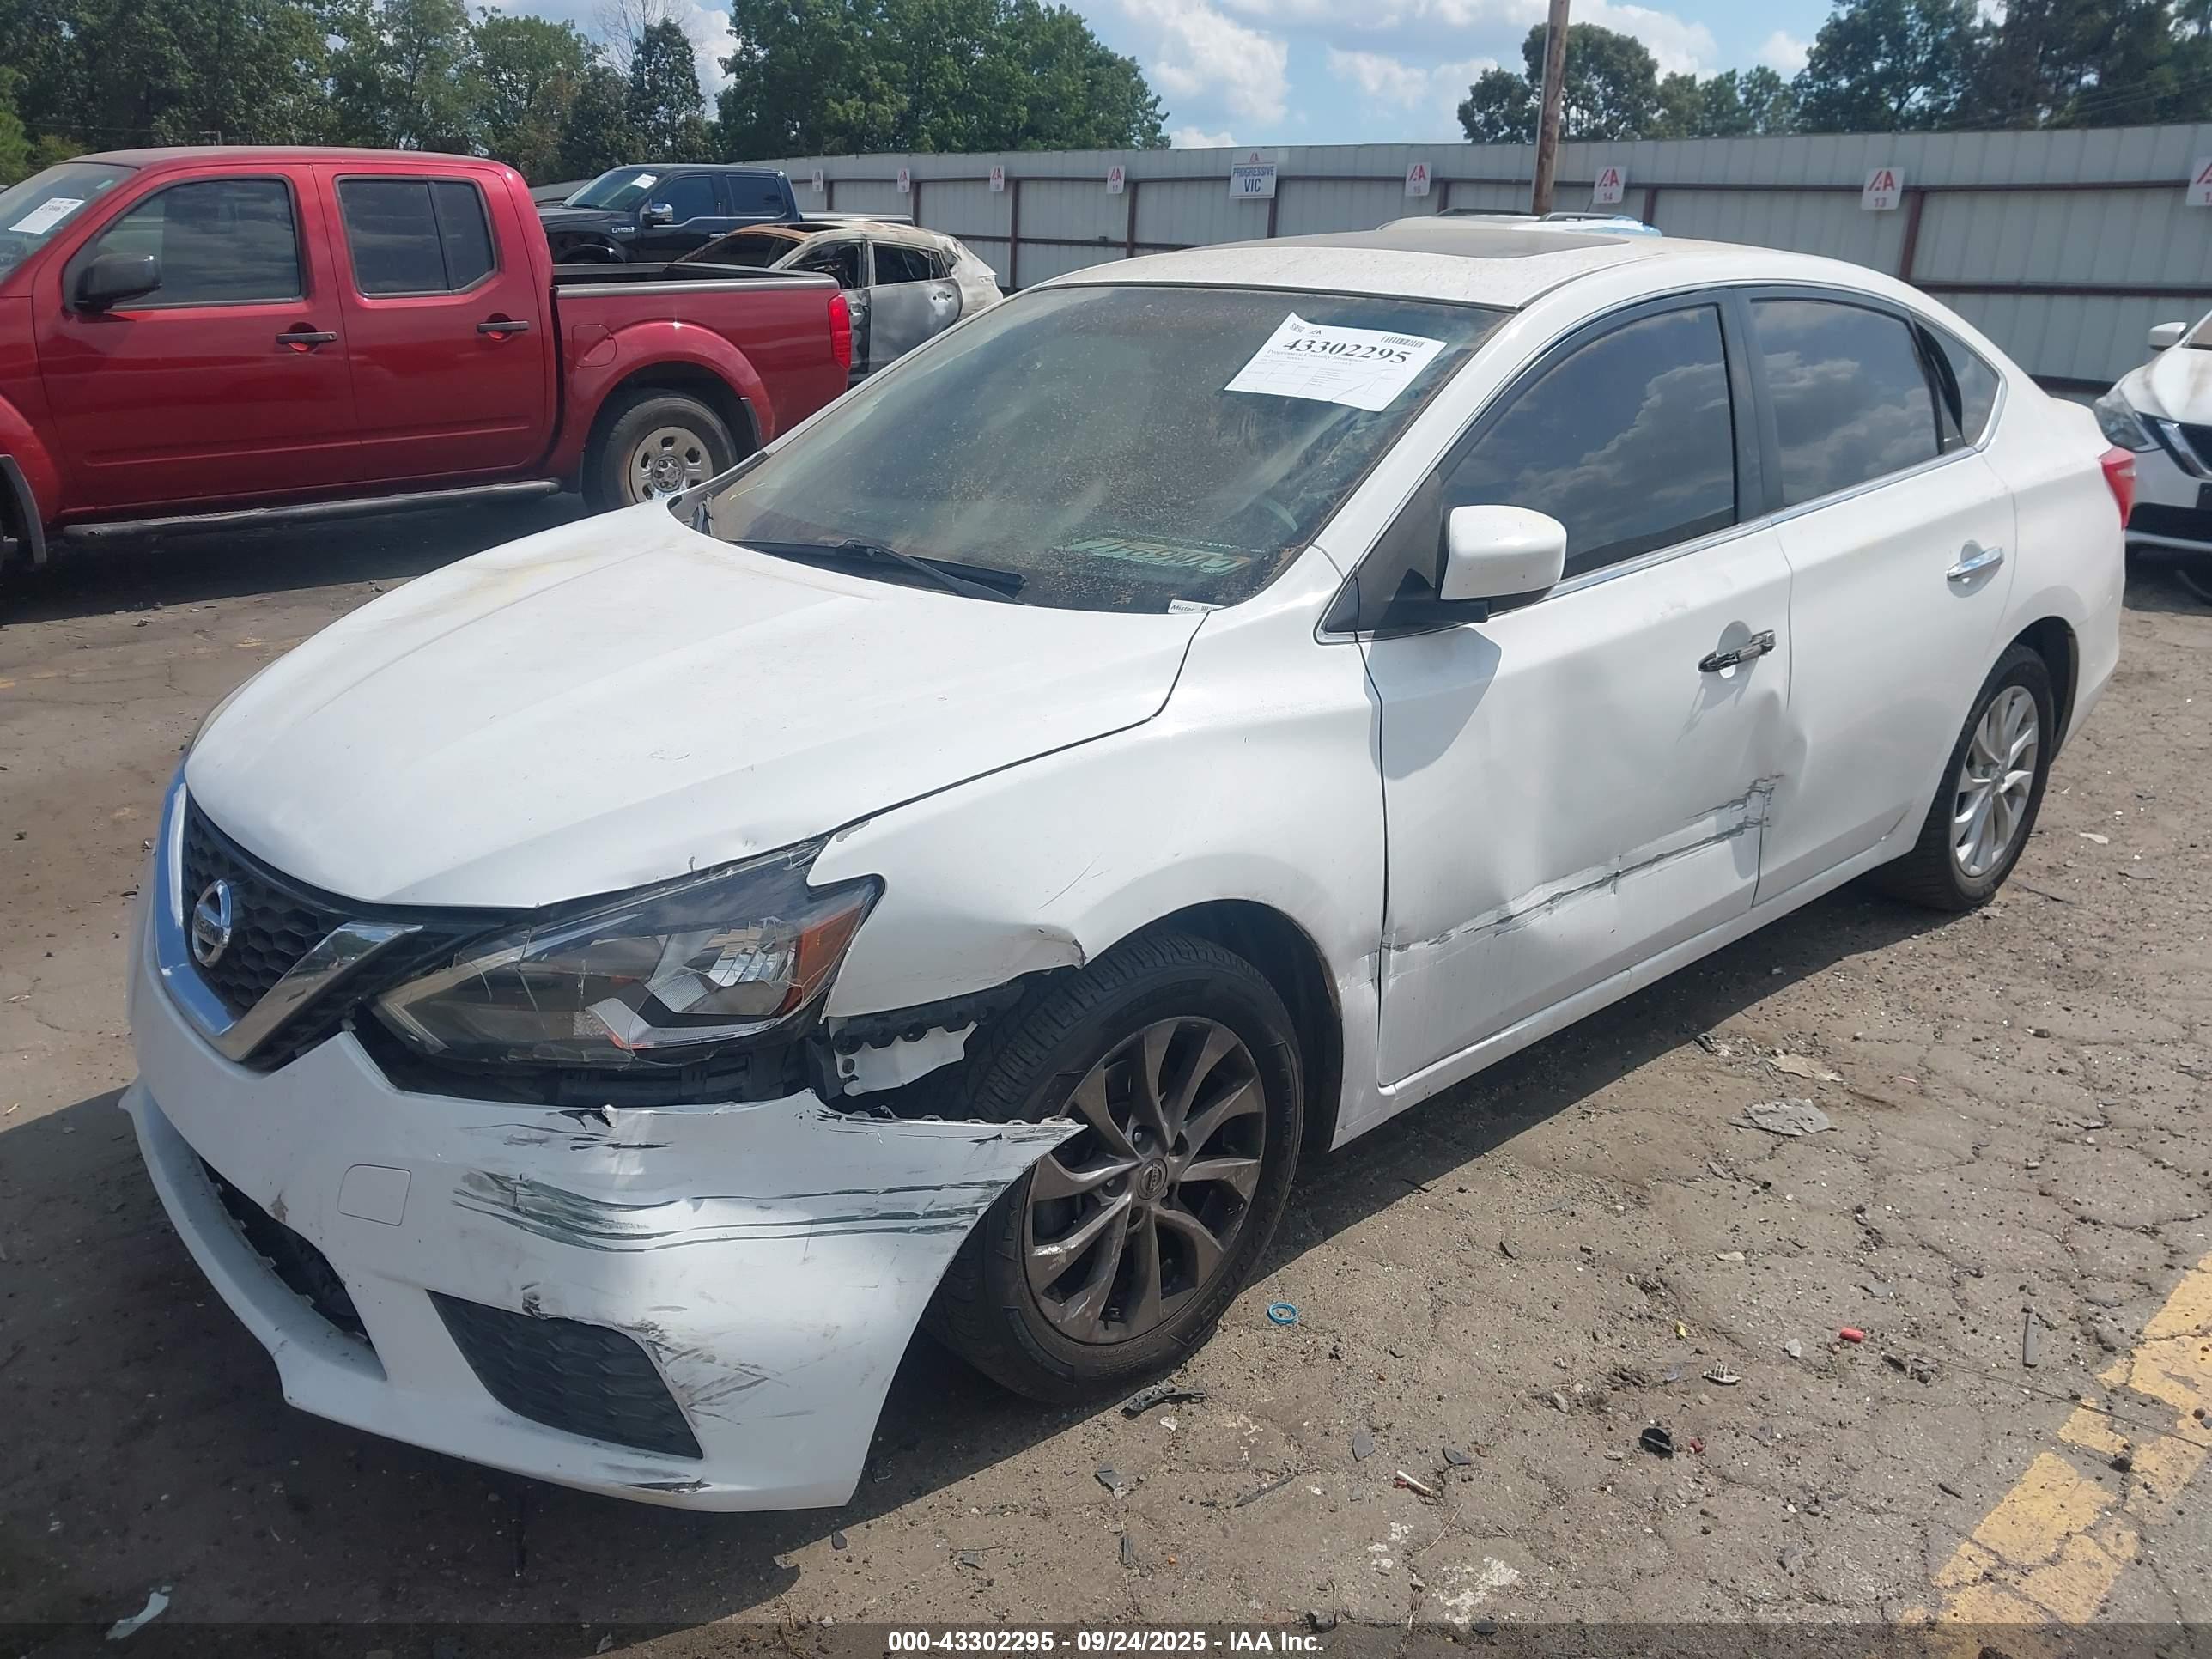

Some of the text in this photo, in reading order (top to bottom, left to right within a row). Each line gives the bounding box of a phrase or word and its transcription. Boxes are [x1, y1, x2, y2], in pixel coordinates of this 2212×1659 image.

[1233, 166, 1275, 178] PROGRESSIVE
[1244, 178, 1261, 193] VIC
[1283, 338, 1413, 364] 43302295
